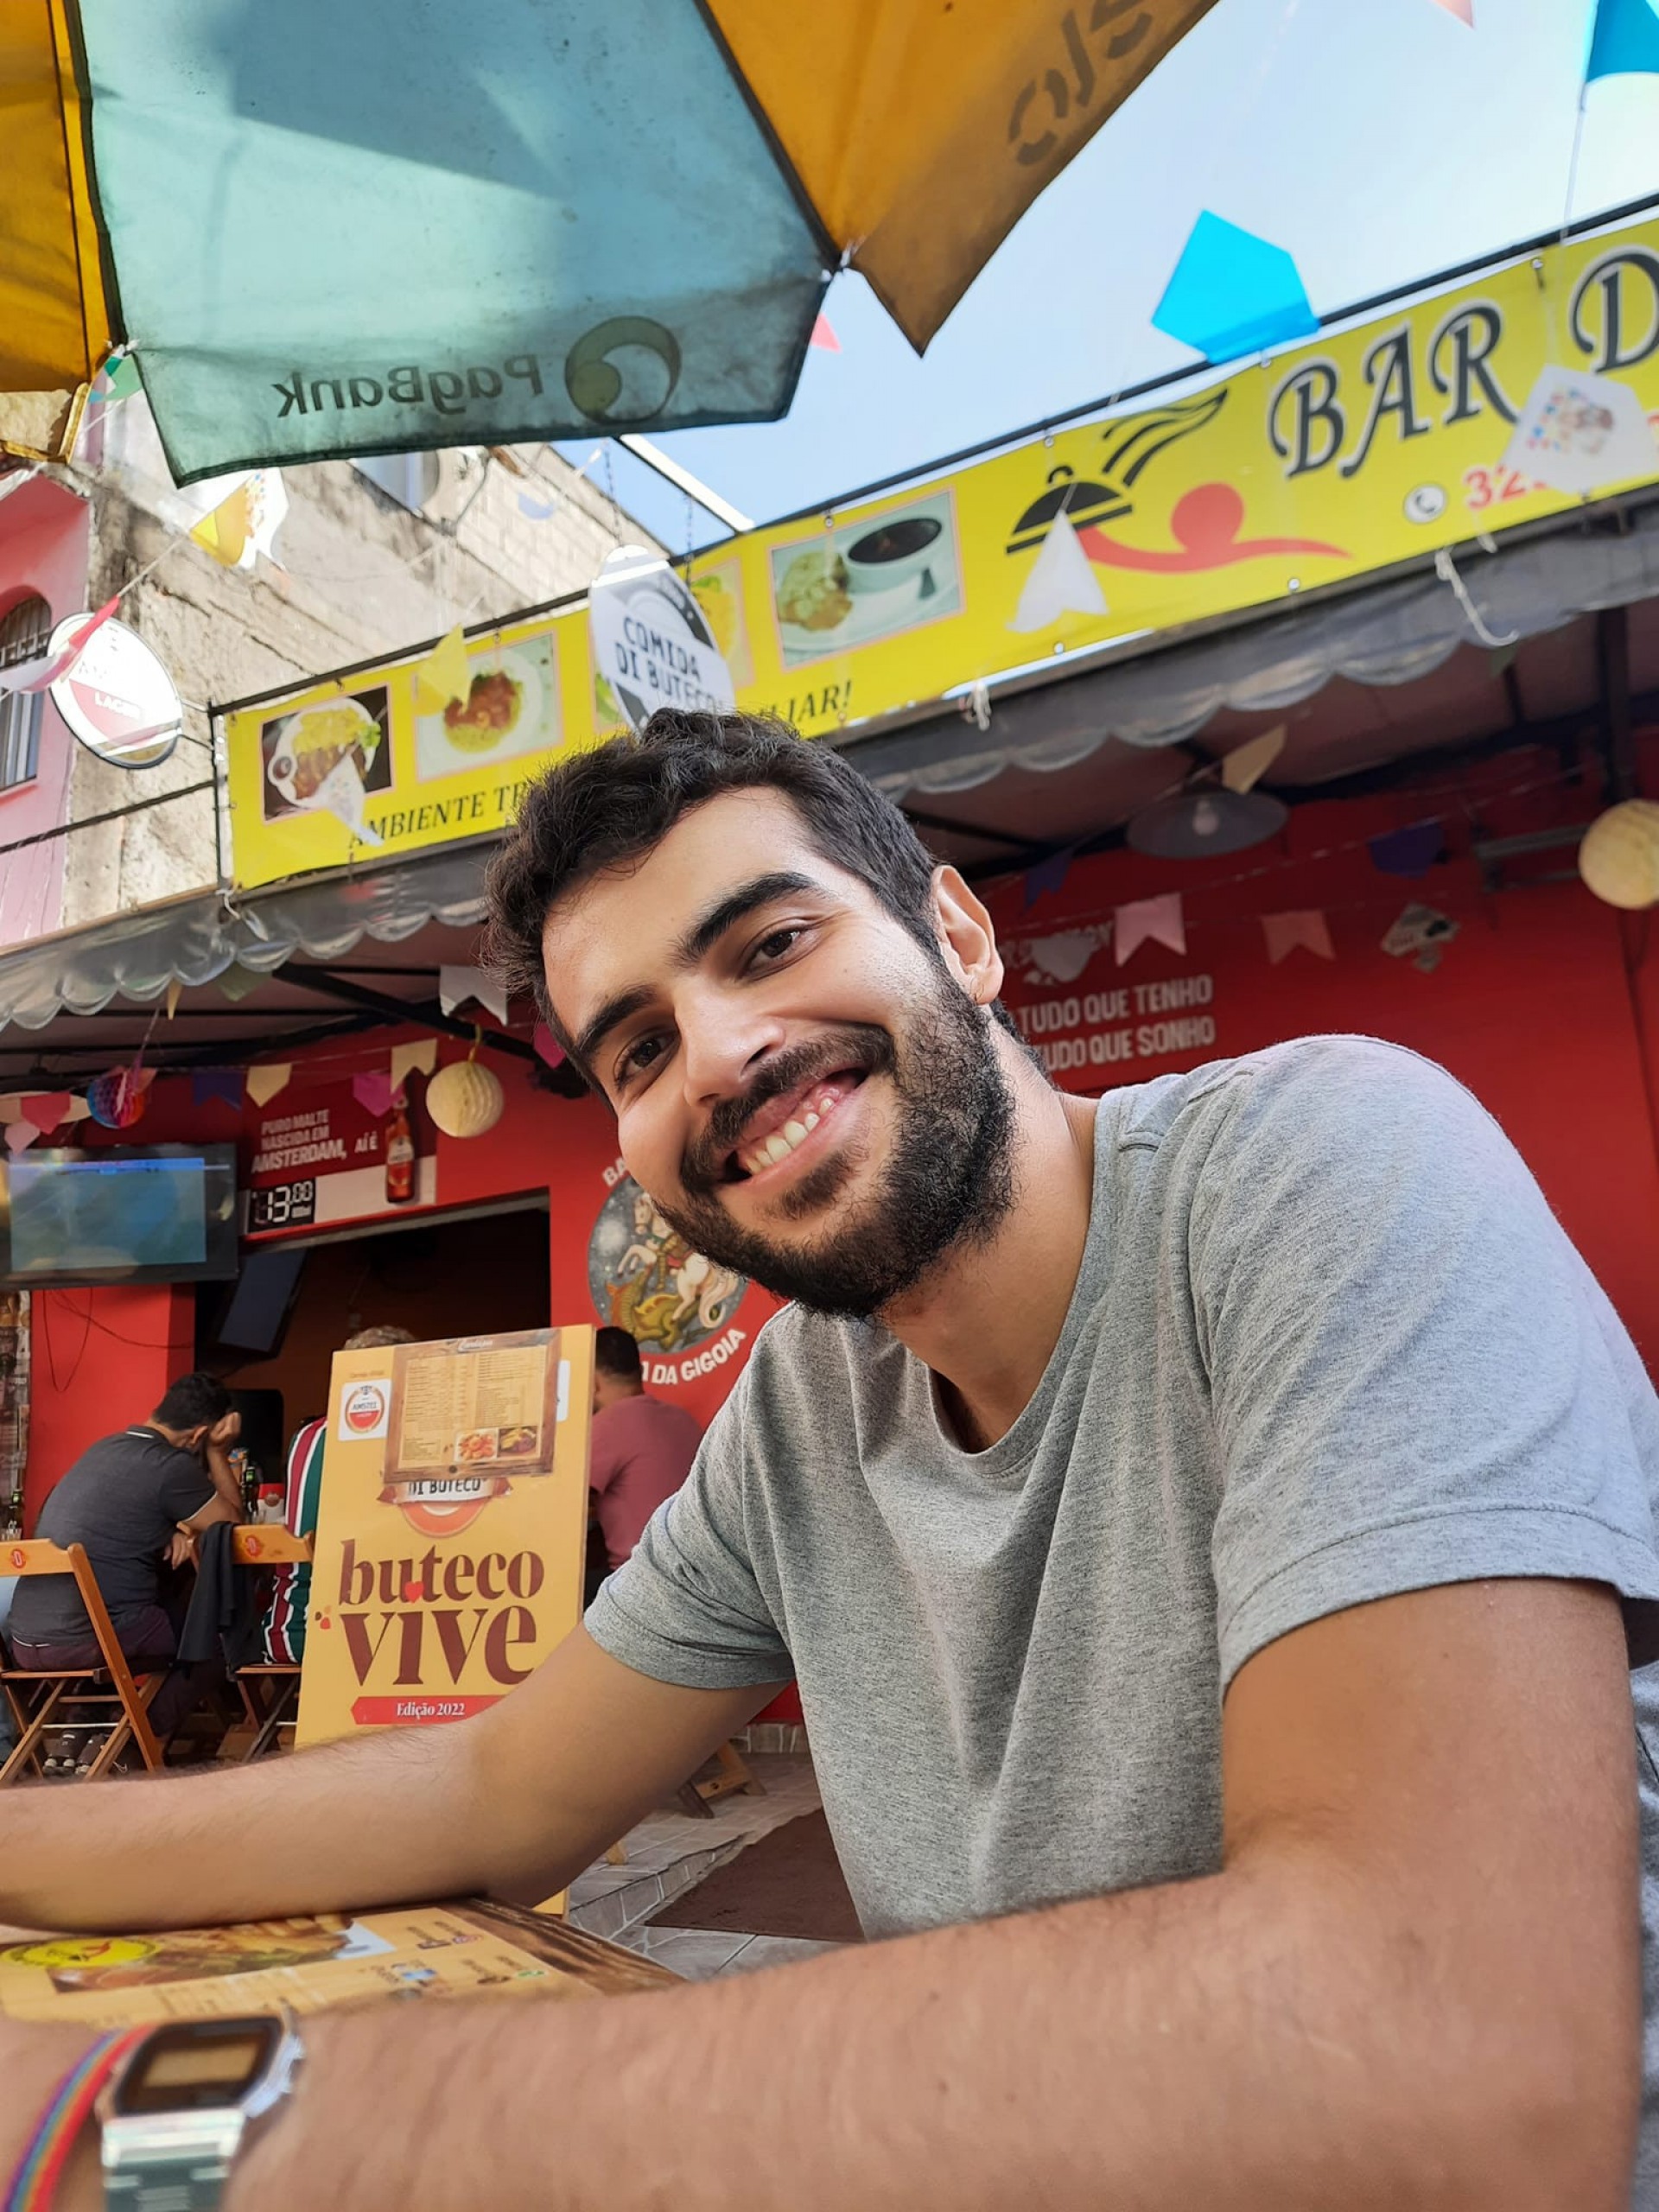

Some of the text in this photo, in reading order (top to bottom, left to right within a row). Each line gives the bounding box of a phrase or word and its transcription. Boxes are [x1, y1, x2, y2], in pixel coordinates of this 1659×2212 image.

[1268, 299, 1520, 480] BAR
[615, 641, 719, 712] DI BUTECO
[623, 616, 702, 682] COMIDA
[1019, 975, 1213, 1034] TUDO QUE TENHO
[1090, 1029, 1134, 1065] QUE
[1136, 1017, 1216, 1058] SONHO
[251, 1138, 347, 1173] AMSTERDAM,
[311, 1124, 330, 1141] EM
[652, 1364, 678, 1385] DA
[681, 1328, 747, 1382] GIGOIA
[339, 1538, 545, 1606] buteco
[339, 1605, 537, 1687] vive
[396, 1701, 467, 1721] Edição 2022
